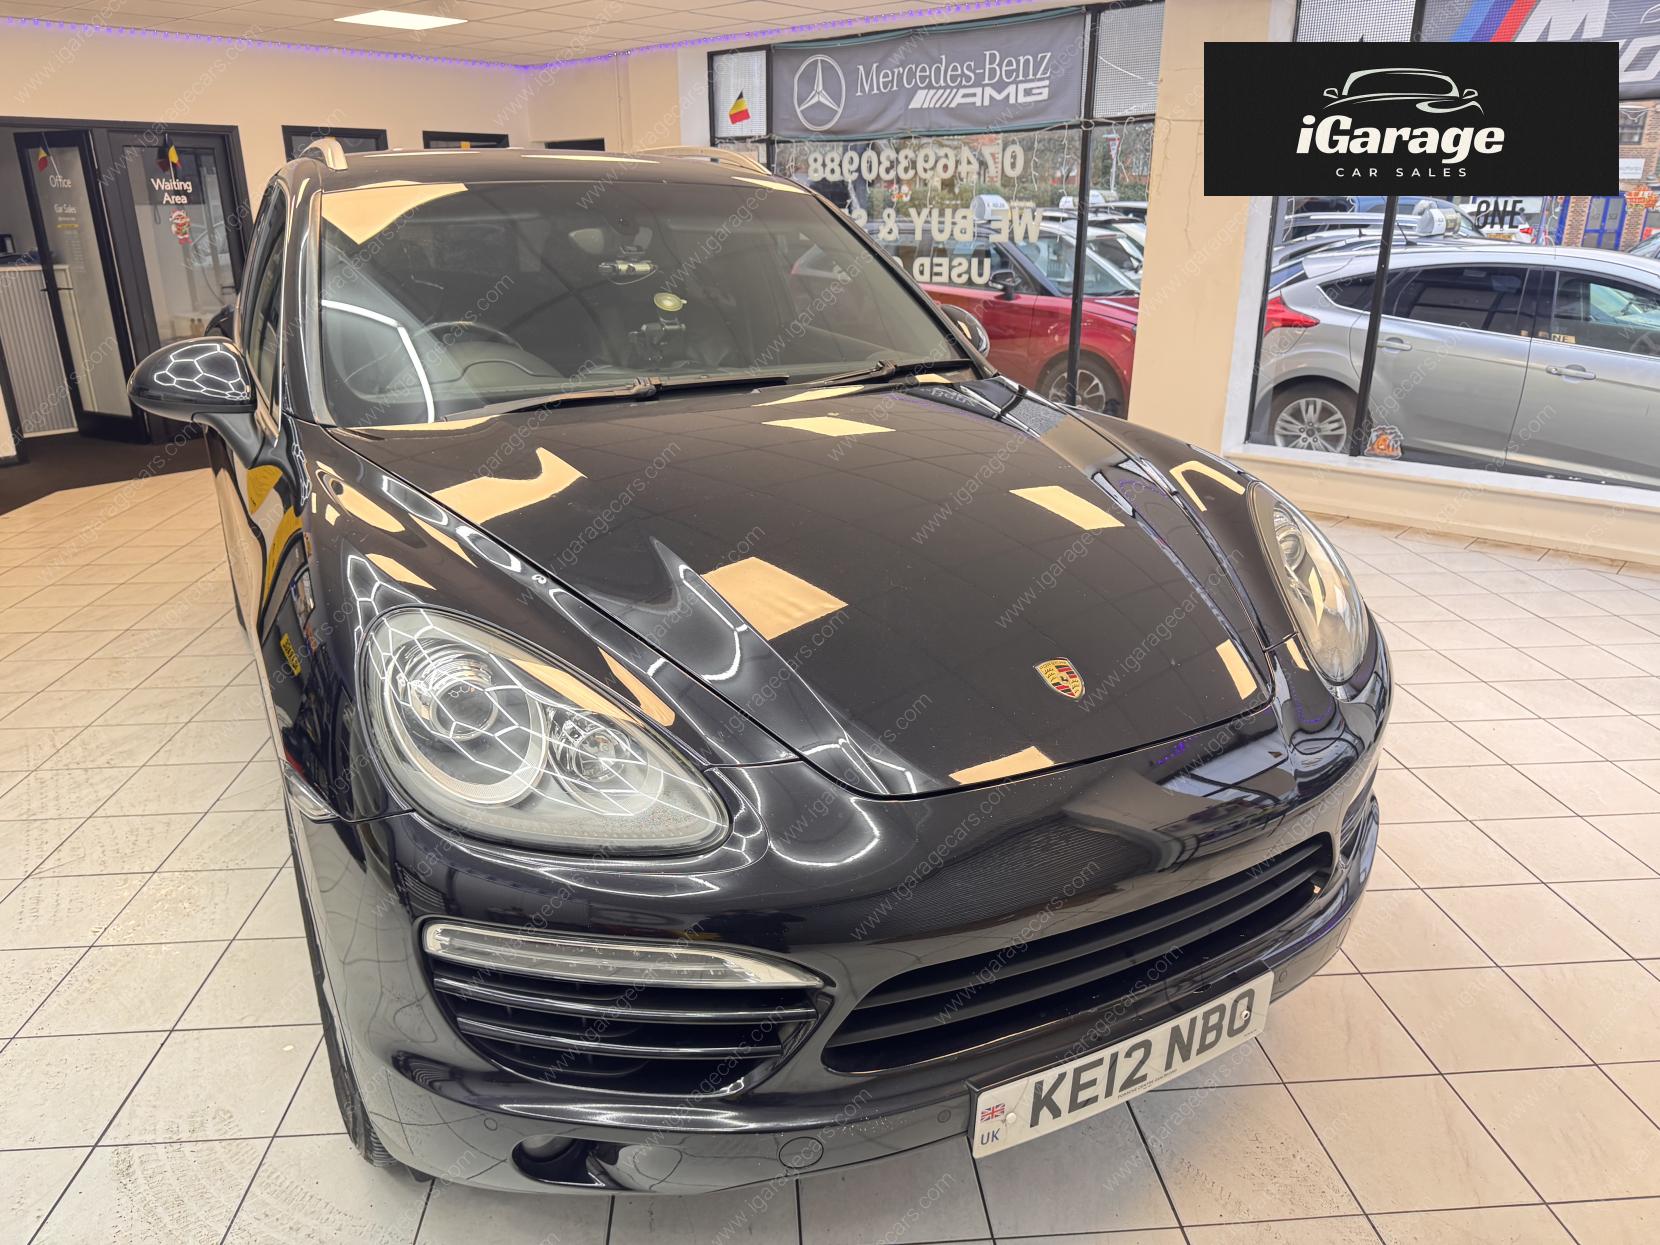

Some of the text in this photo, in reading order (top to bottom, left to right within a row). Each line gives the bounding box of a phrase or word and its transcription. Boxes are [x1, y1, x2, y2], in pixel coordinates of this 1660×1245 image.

[856, 50, 1052, 96] Mercedes-Benz
[49, 174, 72, 188] Office
[151, 178, 192, 193] Waiting
[163, 194, 188, 204] Area
[1165, 988, 1254, 1072] NBO
[980, 1128, 1000, 1146] UK
